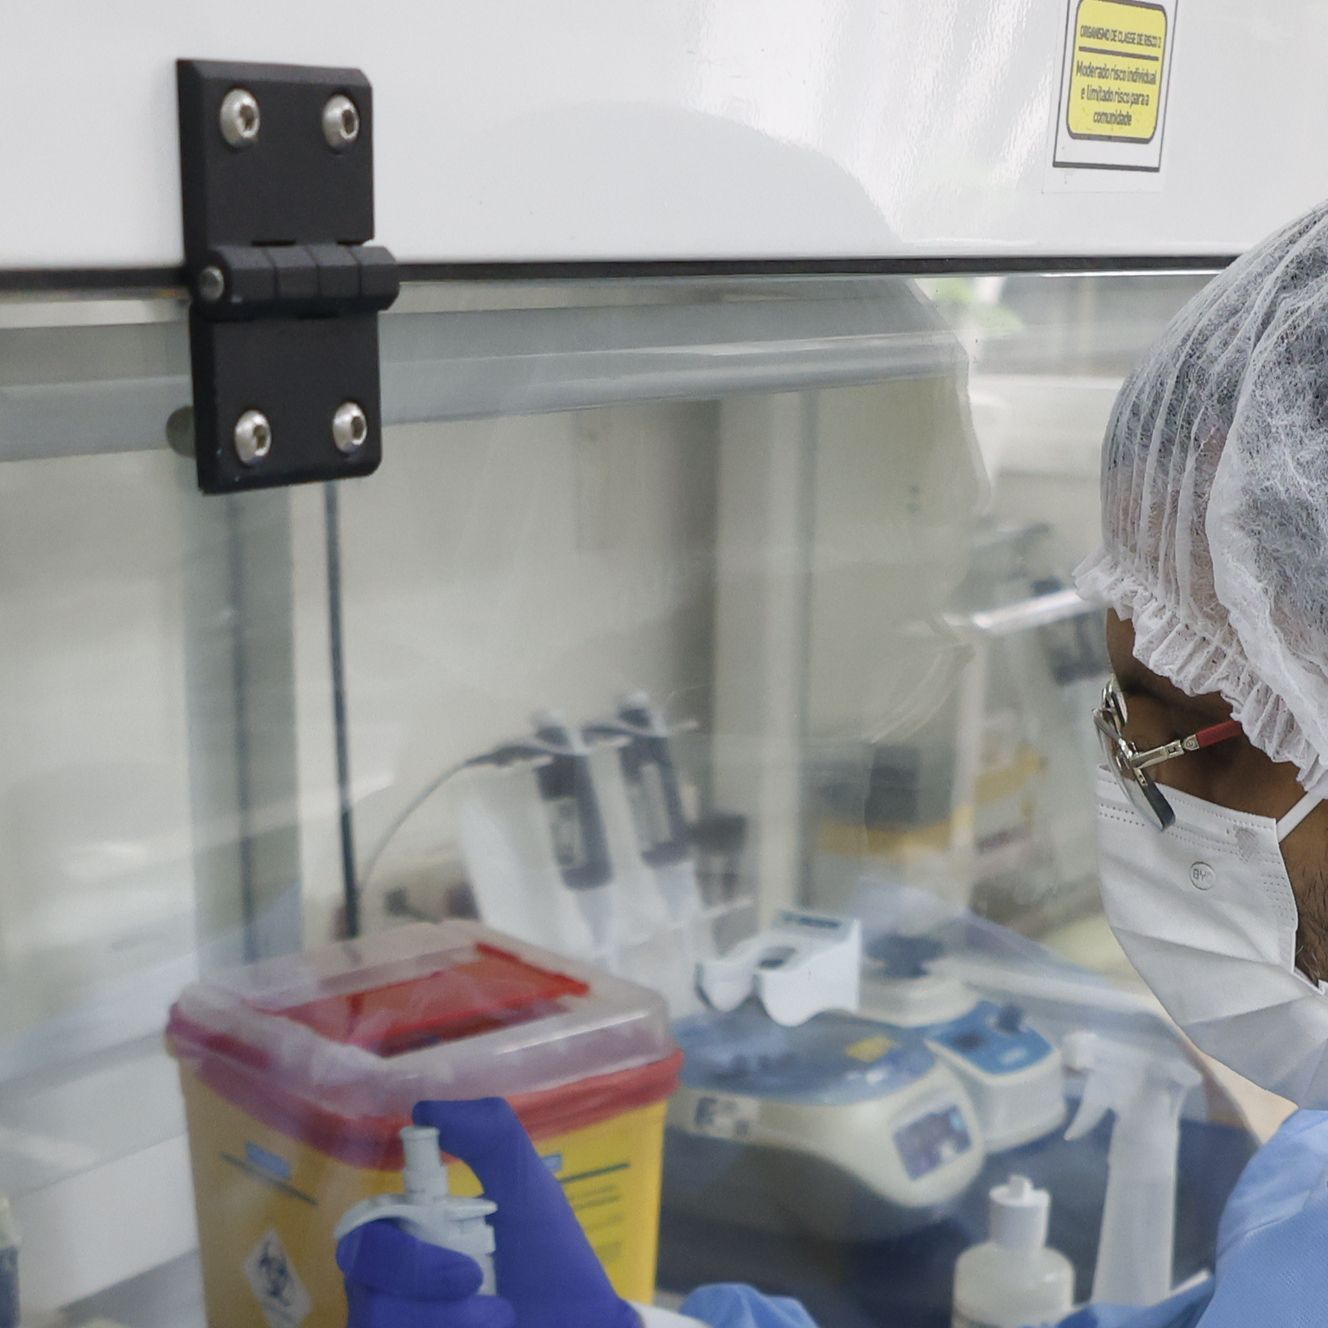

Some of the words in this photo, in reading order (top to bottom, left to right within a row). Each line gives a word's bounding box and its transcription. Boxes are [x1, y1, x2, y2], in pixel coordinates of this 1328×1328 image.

[1076, 60, 1111, 79] Moderado
[1111, 64, 1127, 82] risco
[1127, 66, 1158, 85] individual
[1115, 87, 1129, 104] risco
[1129, 92, 1145, 109] para
[1093, 109, 1132, 126] comunidade
